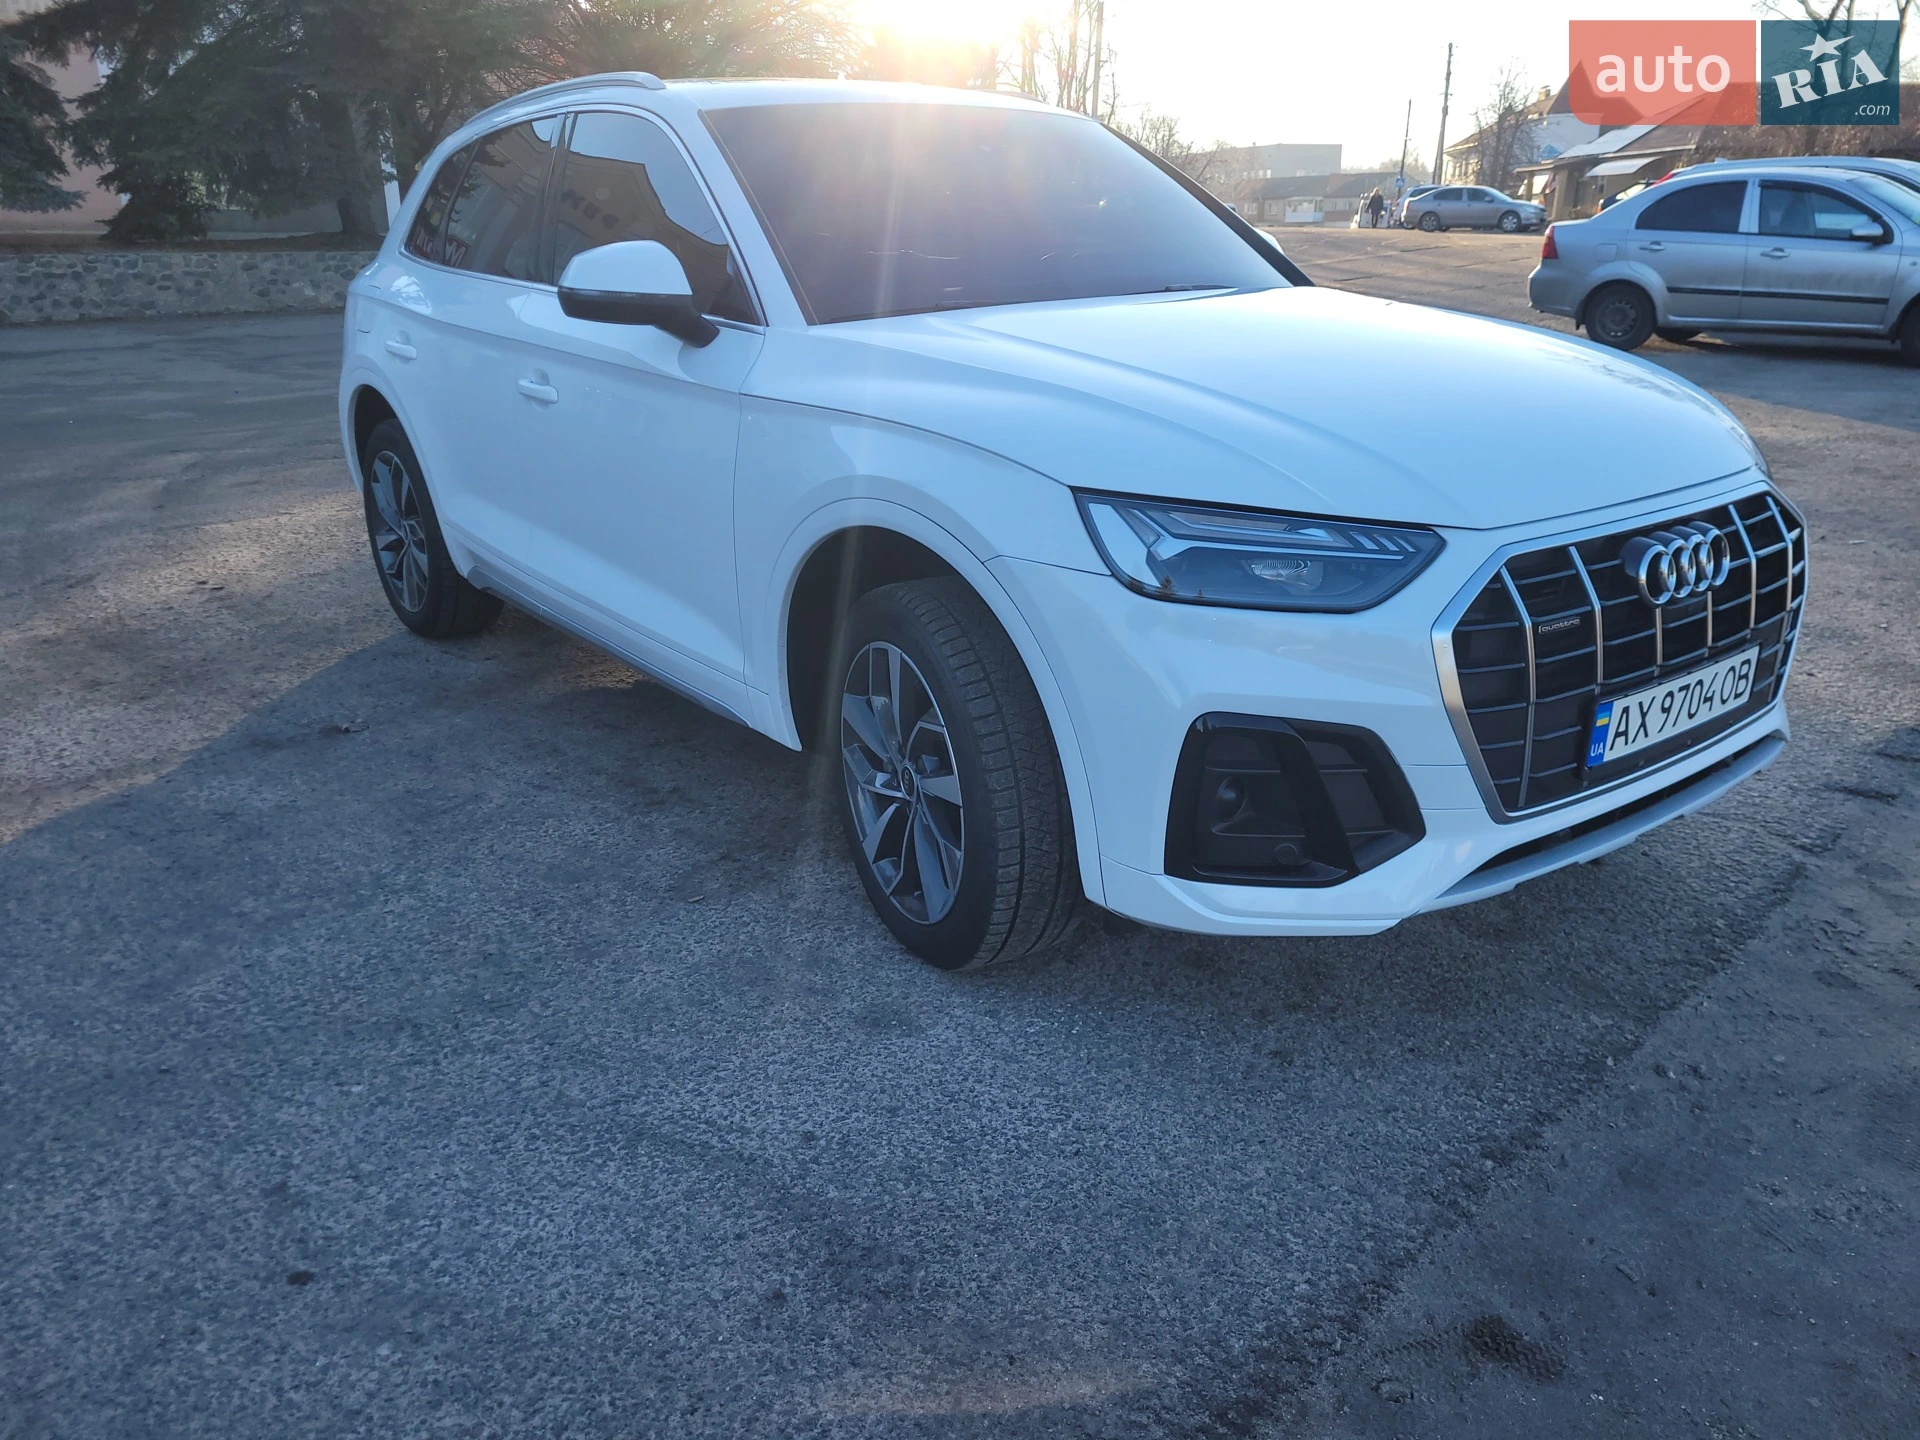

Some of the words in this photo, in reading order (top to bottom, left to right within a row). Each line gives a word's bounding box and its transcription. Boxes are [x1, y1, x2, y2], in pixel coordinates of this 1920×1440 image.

[1541, 619, 1580, 632] quattro
[1609, 695, 1656, 751] AX
[1657, 672, 1718, 734] 9704
[1720, 658, 1752, 705] OB
[1590, 742, 1604, 757] UA
